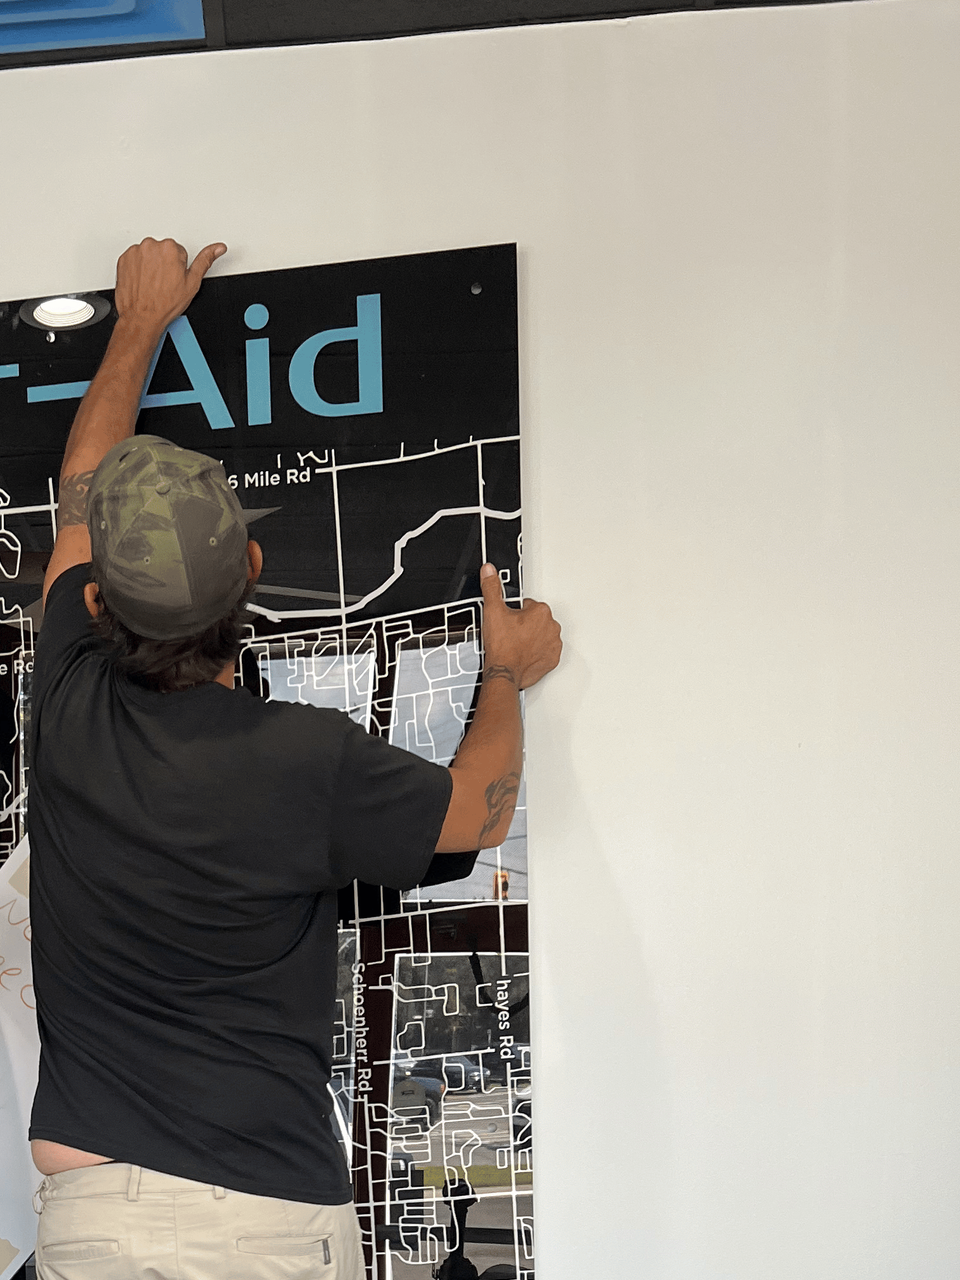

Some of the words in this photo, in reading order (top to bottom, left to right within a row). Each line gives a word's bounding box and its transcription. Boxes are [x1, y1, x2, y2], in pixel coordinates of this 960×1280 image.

[227, 474, 239, 489] 6
[244, 470, 281, 488] Mile
[286, 466, 311, 484] Rd
[352, 962, 370, 1063] Schoenherr
[494, 979, 512, 1030] hayes
[499, 1035, 516, 1059] Rd
[357, 1068, 373, 1092] Rd
